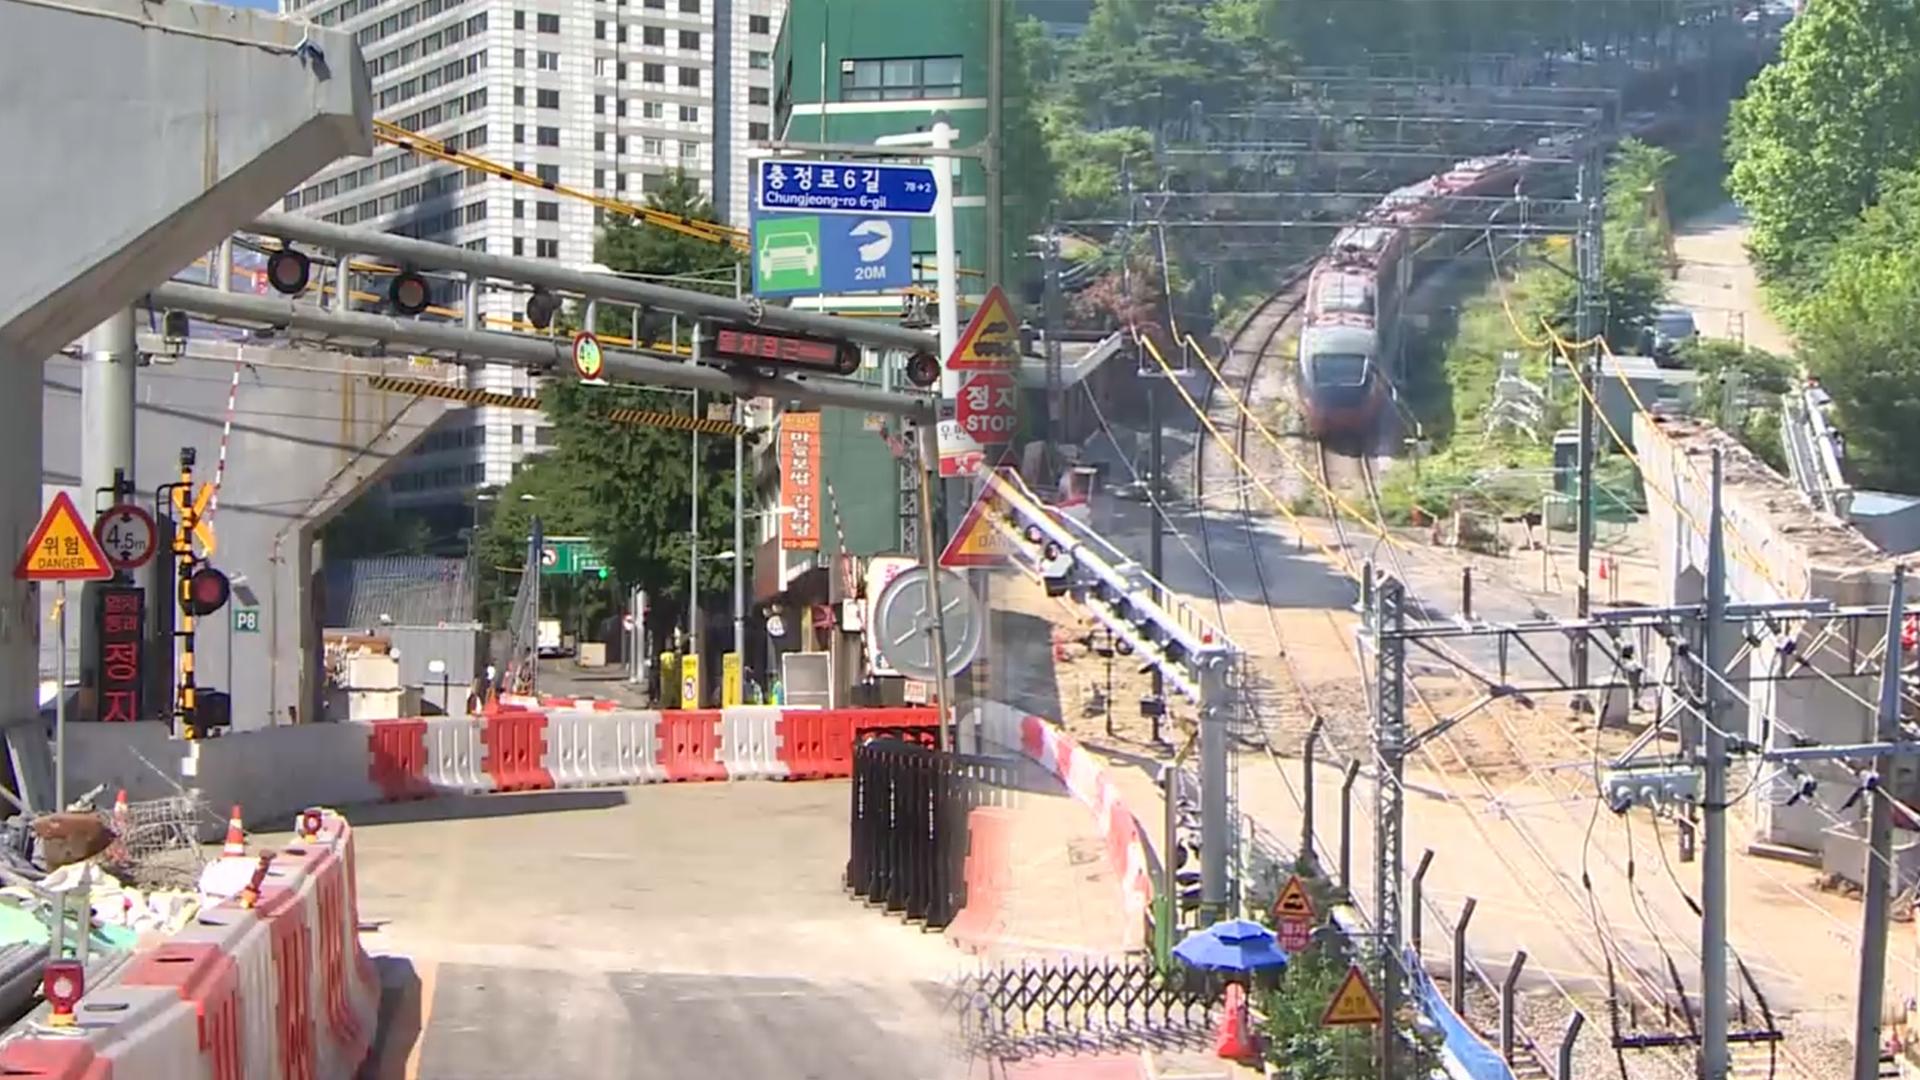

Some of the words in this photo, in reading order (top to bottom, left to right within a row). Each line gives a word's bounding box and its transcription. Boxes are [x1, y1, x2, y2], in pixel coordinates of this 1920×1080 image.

[766, 191, 856, 207] Chungjeong-ro
[859, 196, 887, 209] 6-gil
[854, 266, 886, 281] 20M
[966, 385, 1017, 411] 정지
[966, 415, 1017, 432] STOP
[43, 536, 79, 556] 위험
[38, 557, 85, 569] DANGER
[237, 612, 255, 630] P8
[103, 642, 138, 722] 정지
